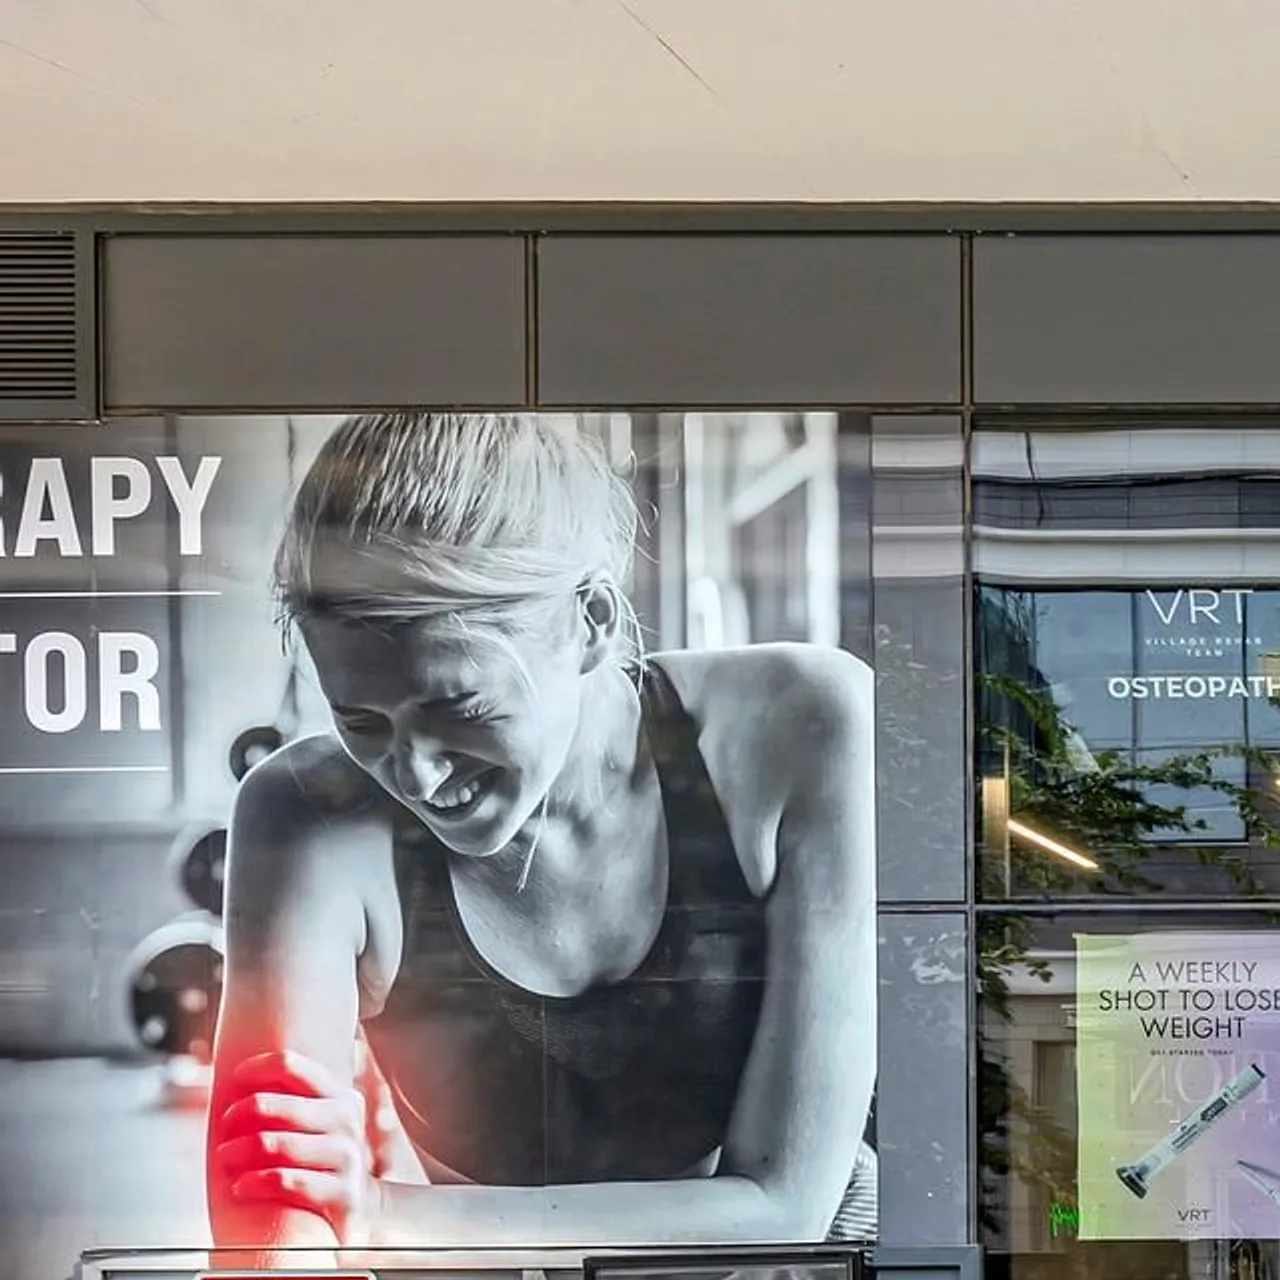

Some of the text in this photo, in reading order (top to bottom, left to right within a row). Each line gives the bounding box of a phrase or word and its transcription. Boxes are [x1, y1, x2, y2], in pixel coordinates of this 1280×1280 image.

[0, 457, 222, 557] APY
[1145, 589, 1254, 625] VRT
[1145, 637, 1207, 646] VILLAGE
[1186, 649, 1223, 657] TEAM
[1128, 962, 1258, 983] A WEEKLY
[1099, 989, 1169, 1011] SHOT
[1181, 989, 1215, 1011] TO
[1141, 1017, 1246, 1039] WEIGHT
[1177, 1208, 1211, 1221] VRT
